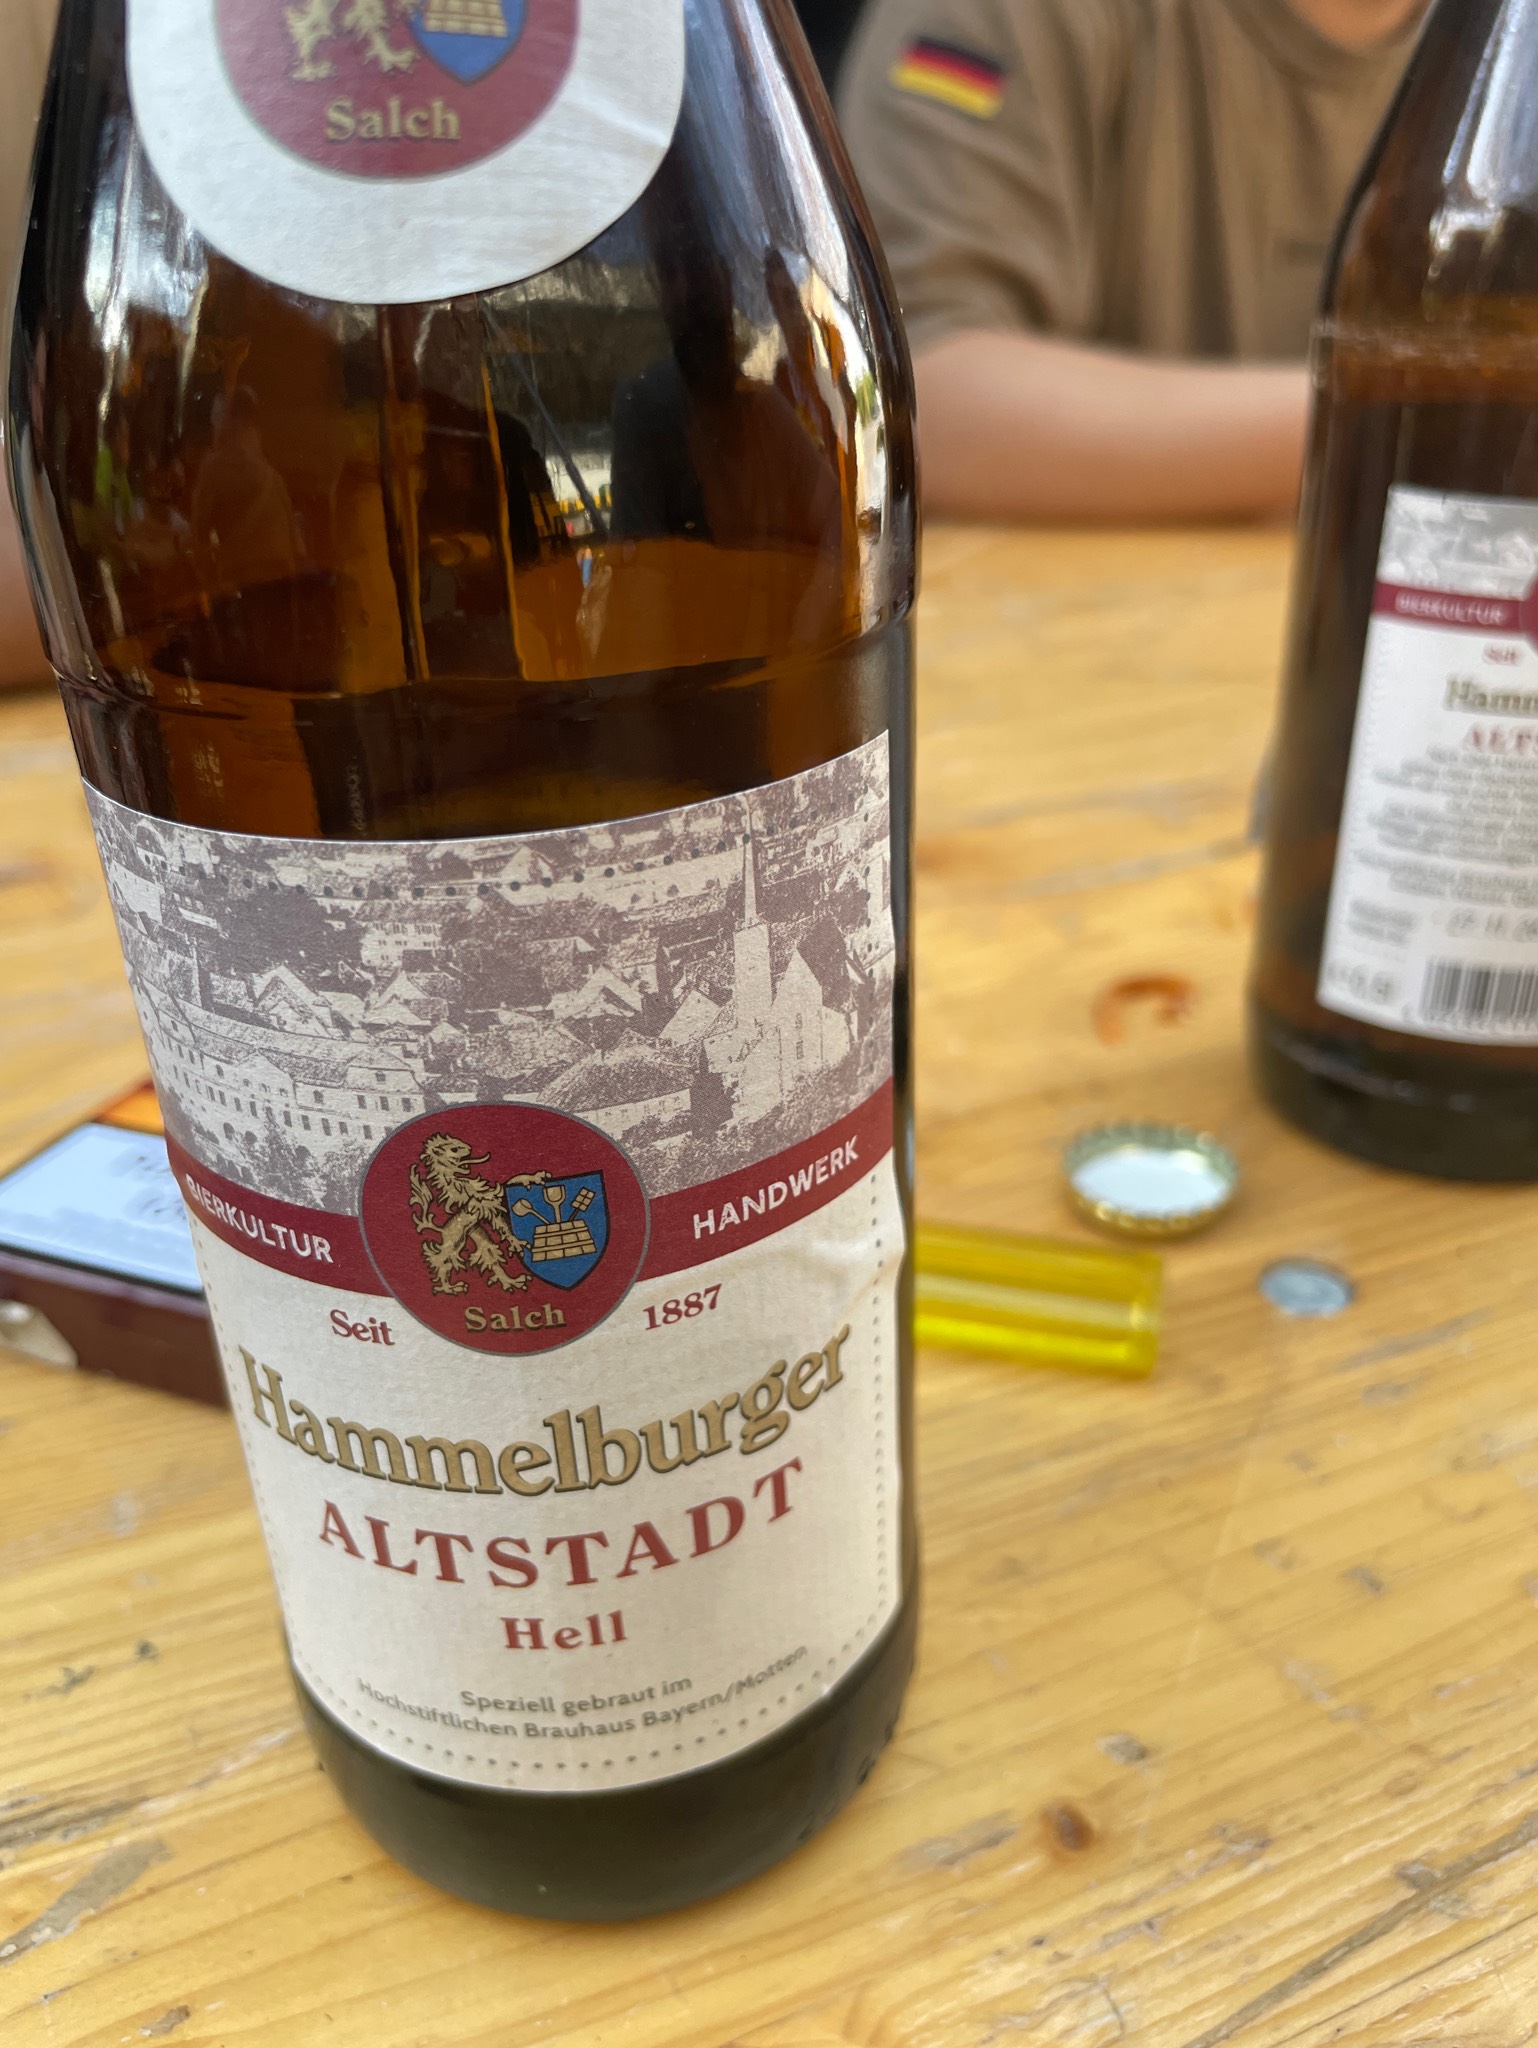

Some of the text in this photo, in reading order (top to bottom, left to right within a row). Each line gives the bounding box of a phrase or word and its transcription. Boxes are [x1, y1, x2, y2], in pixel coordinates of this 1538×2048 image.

[326, 96, 461, 144] Salch
[185, 1173, 334, 1264] BIERKULTUR
[692, 1134, 860, 1240] HANDWERK
[329, 1283, 722, 1346] Seit 1887
[463, 1302, 567, 1333] Salch
[238, 1323, 852, 1496] Hammelburger
[318, 1457, 804, 1588] ALTSTADT
[500, 1610, 629, 1651] Hell
[357, 1645, 809, 1739] Hochstiftlichen Brauhaus Bayern/Motten
[459, 1677, 693, 1717] Speziell gebraut im
